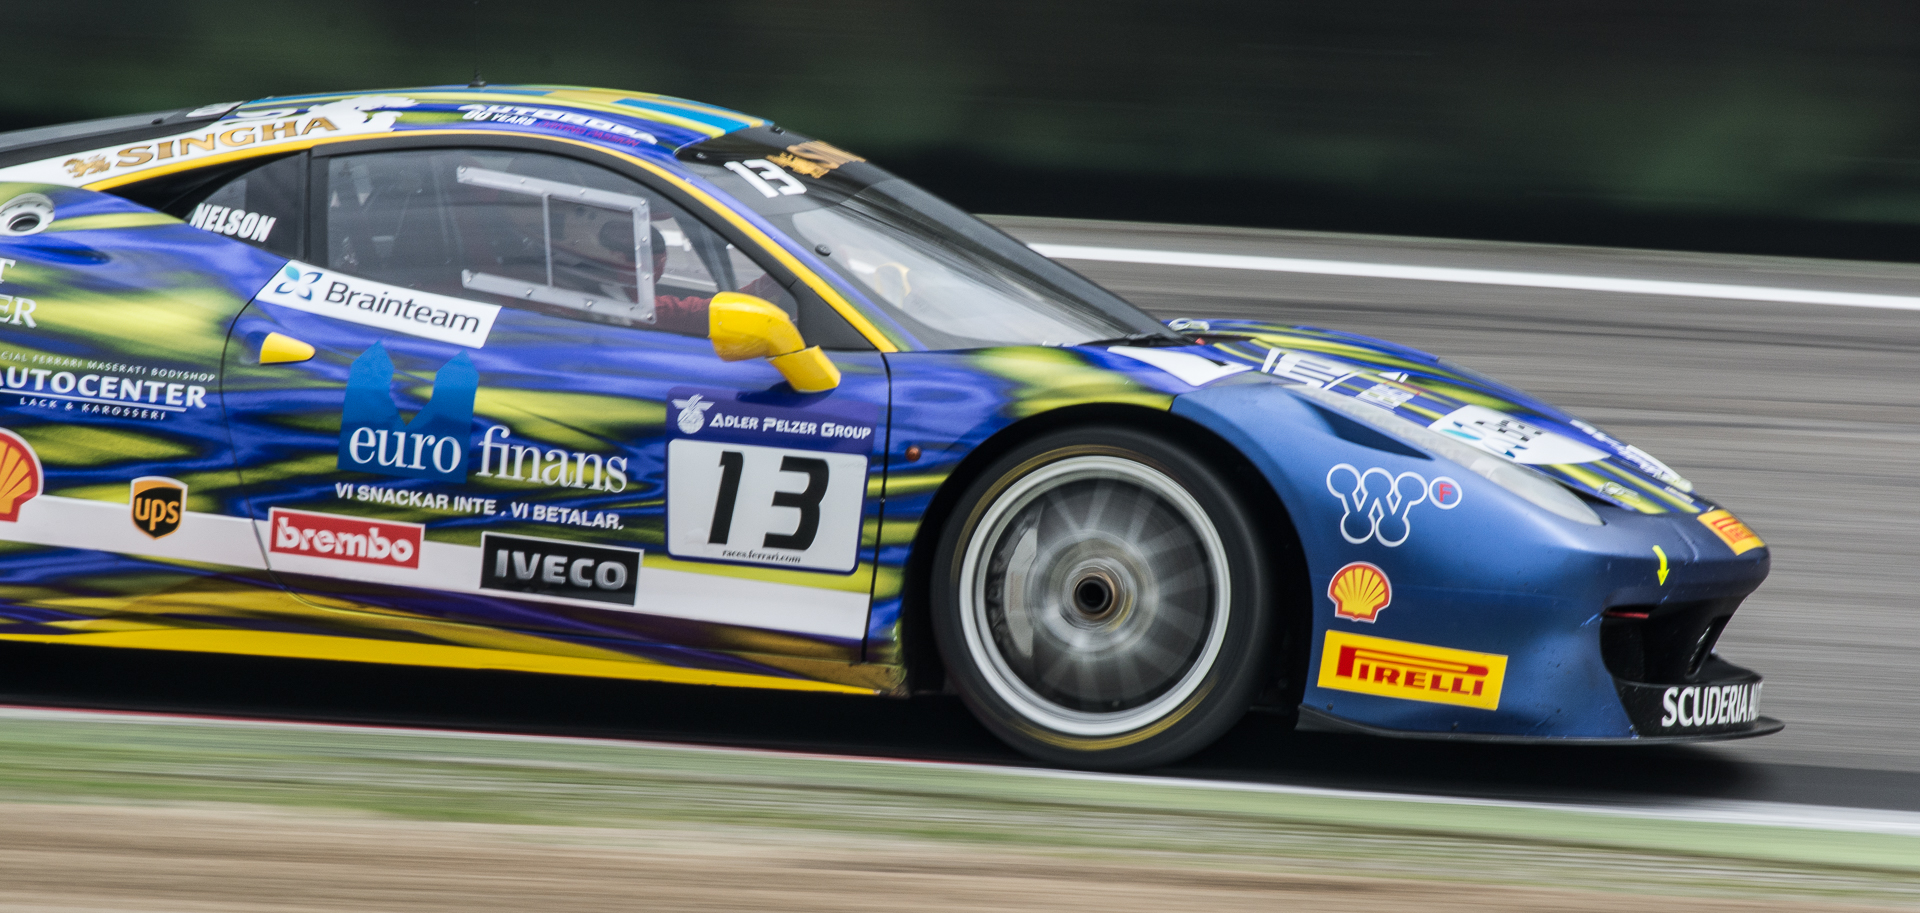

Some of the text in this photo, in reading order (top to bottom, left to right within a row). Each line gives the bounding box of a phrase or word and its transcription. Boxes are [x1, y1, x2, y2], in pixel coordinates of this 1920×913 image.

[115, 116, 340, 168] SINGHA
[723, 158, 808, 199] 13
[189, 202, 277, 243] NELSON
[323, 281, 481, 335] Brainteam
[0, 365, 207, 410] UTOCENTER
[31, 353, 84, 369] FERRARI
[86, 360, 148, 376] MASERATI
[150, 367, 217, 384] BODYSHOP
[19, 396, 58, 409] LACK
[81, 402, 167, 421] KAROSSERI
[709, 412, 873, 441] ADLER PELZER GROUP
[348, 424, 629, 494] euro finans
[334, 482, 354, 499] VI
[356, 487, 449, 511] SNACKAR
[510, 501, 529, 519] VI
[532, 504, 625, 531] BETALAR.
[706, 450, 830, 552] 13
[275, 515, 415, 564] brembo
[494, 547, 629, 592] IVECO
[1335, 644, 1490, 698] PIRELLI
[1661, 683, 1749, 728] SCUDERIA
